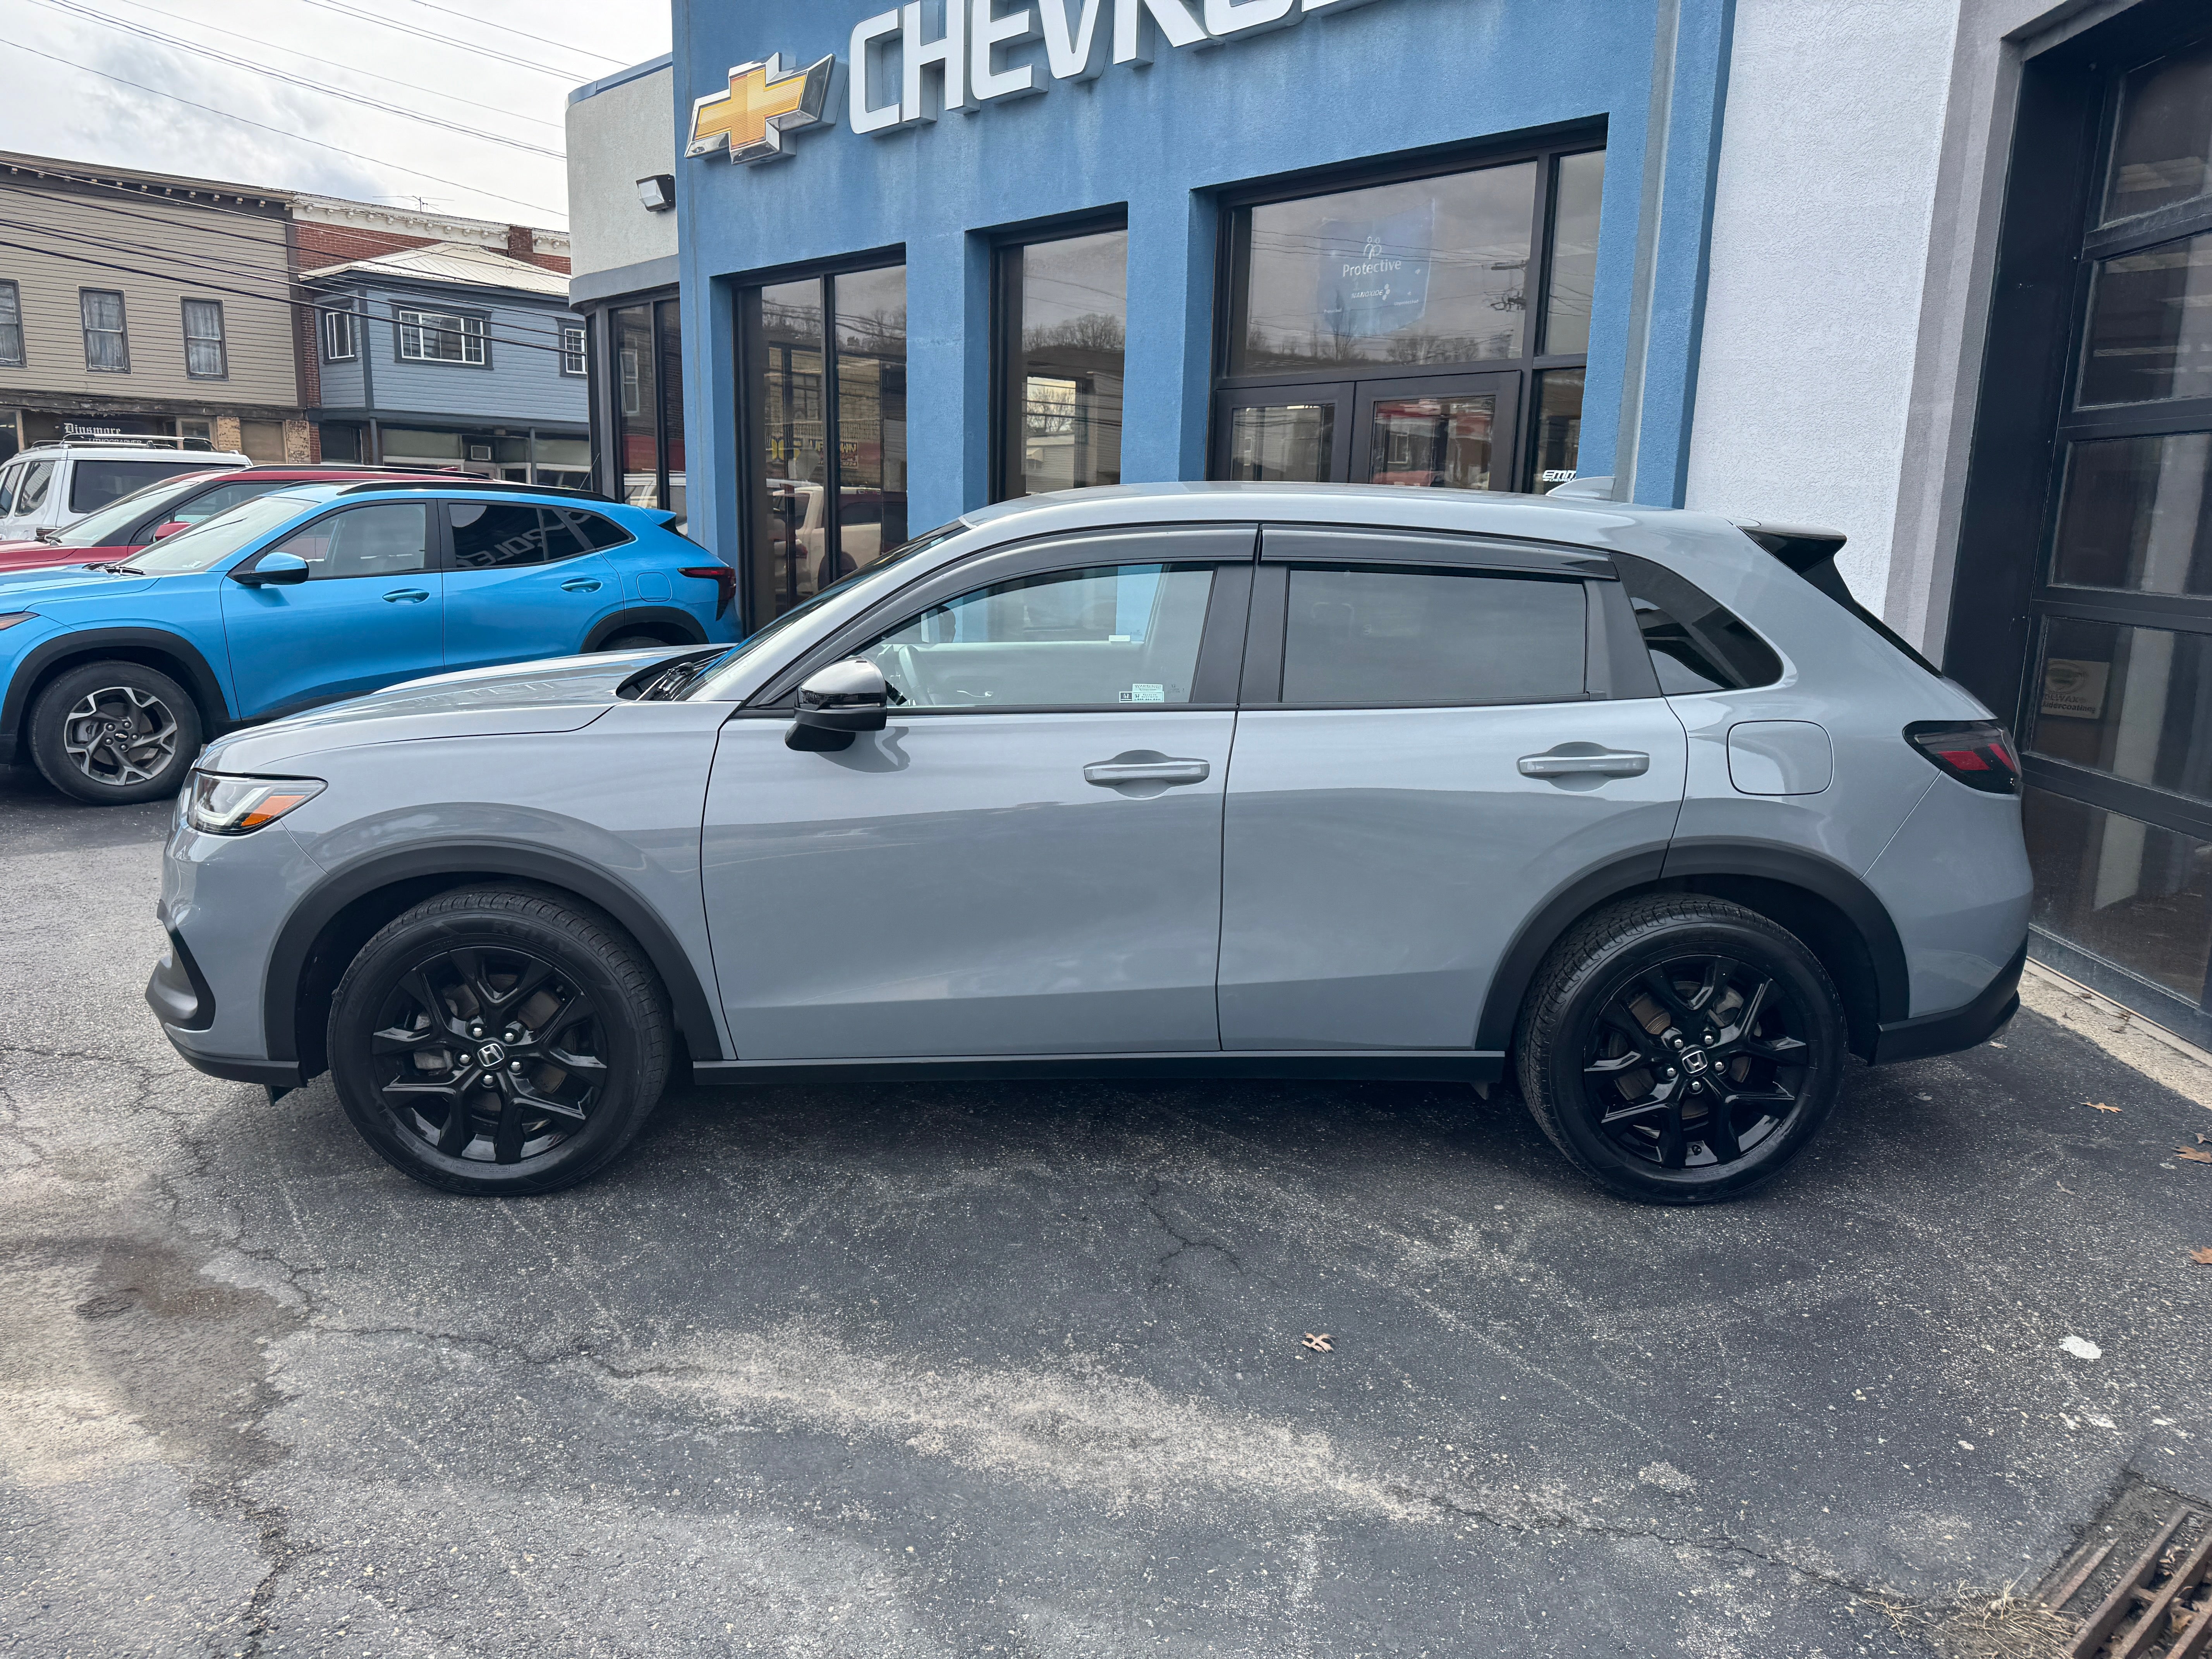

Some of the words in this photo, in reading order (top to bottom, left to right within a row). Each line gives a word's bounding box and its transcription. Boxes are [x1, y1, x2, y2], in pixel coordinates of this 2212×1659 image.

[1343, 259, 1401, 277] Protective
[1351, 290, 1383, 299] NANOXIDE
[64, 423, 121, 434] Dinsmore
